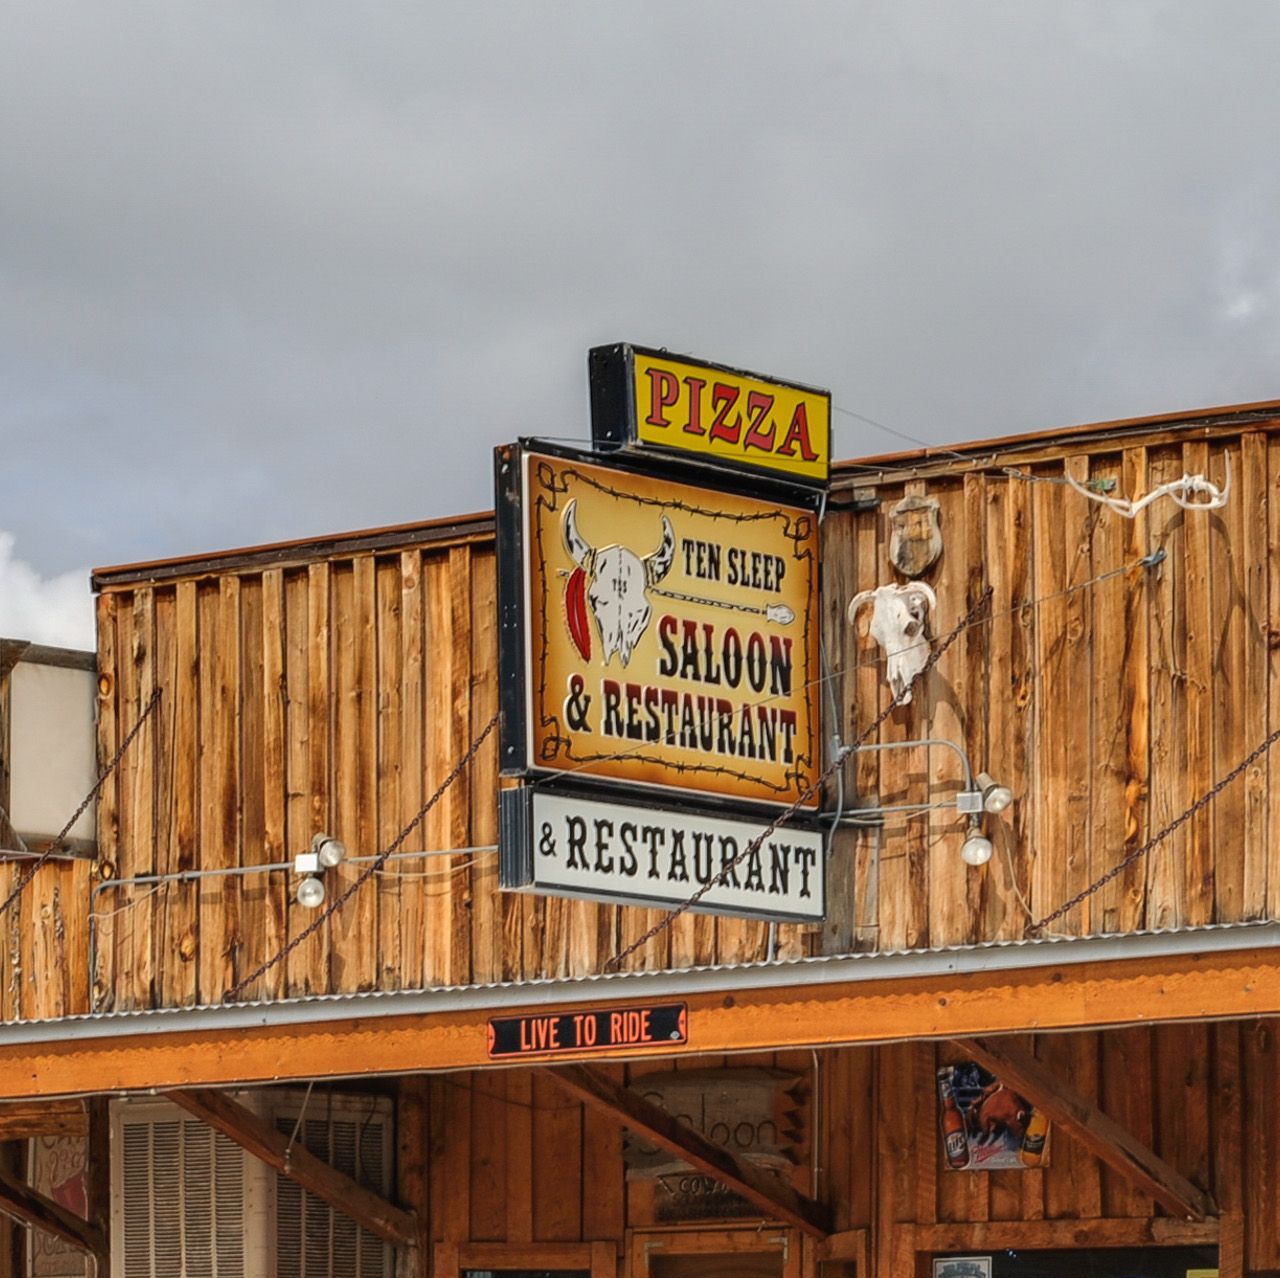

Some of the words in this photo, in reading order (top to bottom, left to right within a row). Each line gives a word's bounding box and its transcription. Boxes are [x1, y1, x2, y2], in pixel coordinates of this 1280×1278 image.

[645, 367, 819, 462] PIZZA
[681, 539, 721, 581] TEN
[727, 547, 786, 593] SLEEP
[657, 614, 793, 696] SALOON
[564, 673, 592, 734] &
[602, 678, 797, 765] RESTAURANT
[540, 822, 557, 857] &
[565, 815, 817, 899] RESTAURANT
[520, 1017, 560, 1050] LIVE
[574, 1015, 597, 1046] TO
[610, 1010, 652, 1043] RIDE
